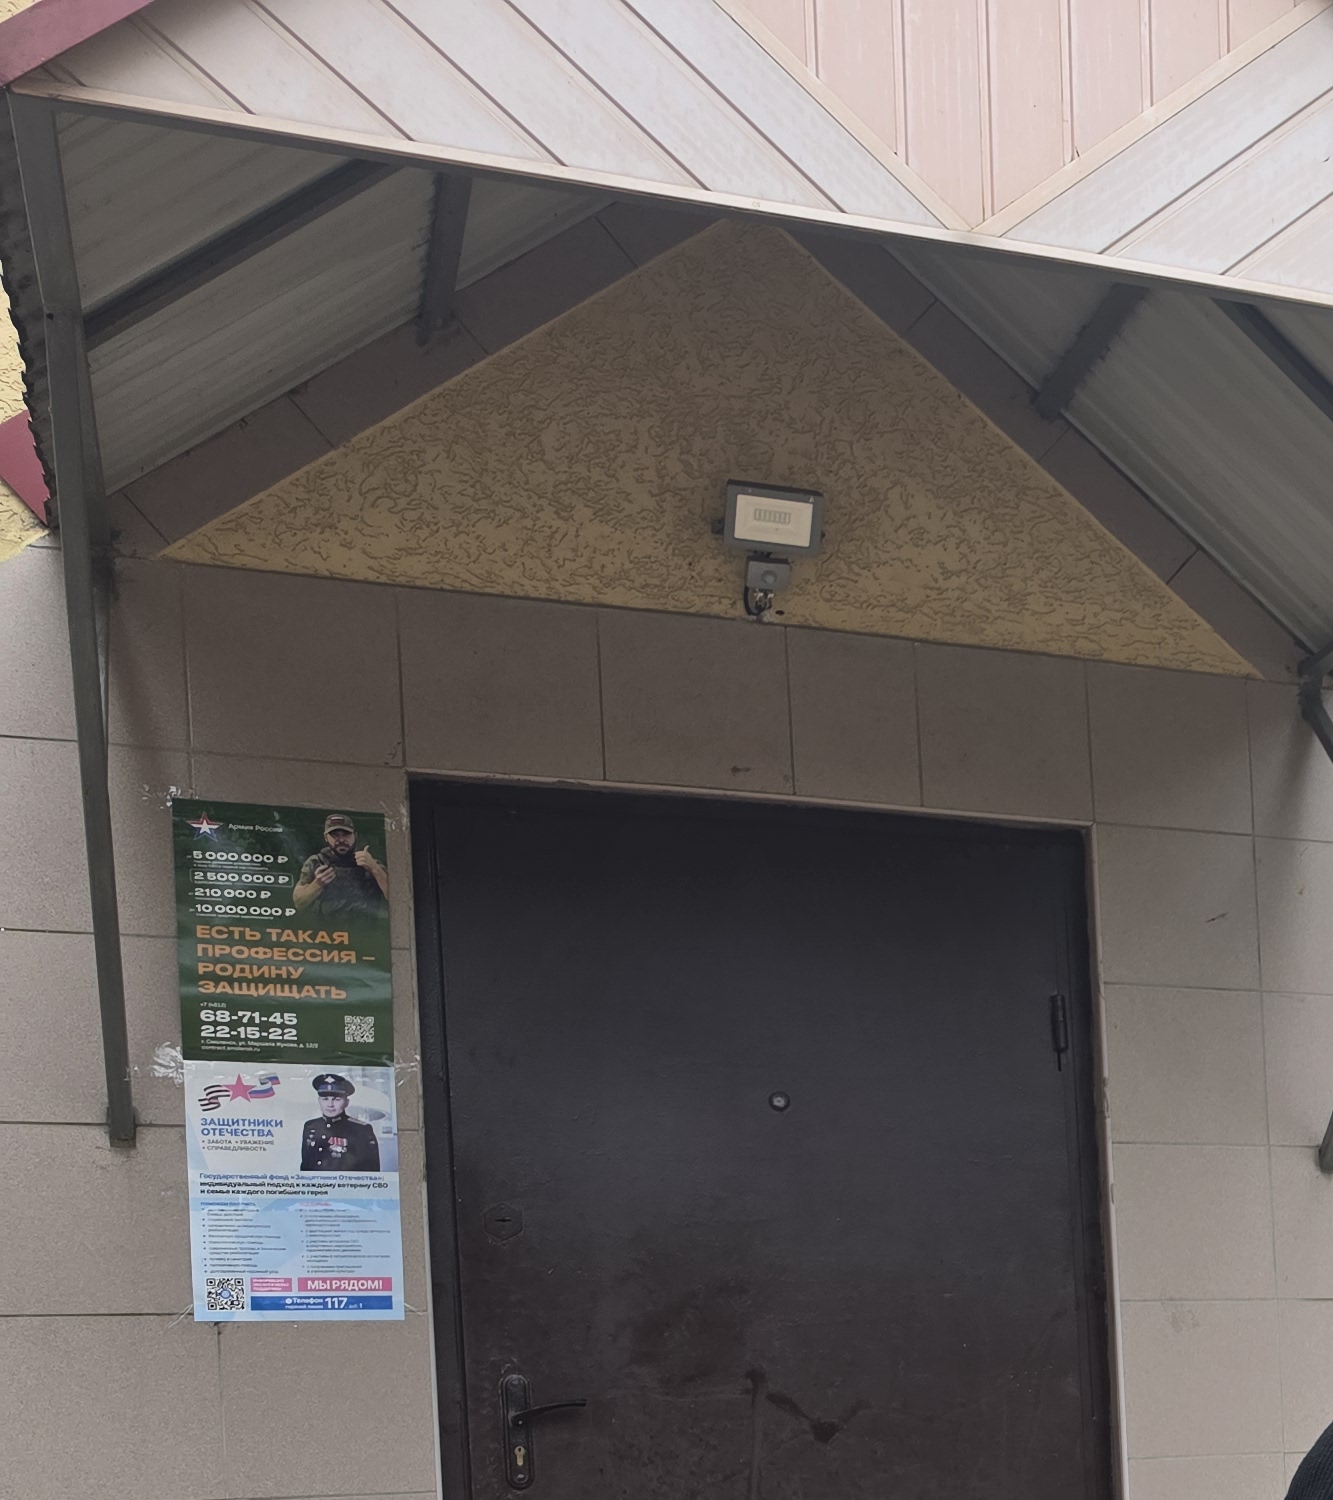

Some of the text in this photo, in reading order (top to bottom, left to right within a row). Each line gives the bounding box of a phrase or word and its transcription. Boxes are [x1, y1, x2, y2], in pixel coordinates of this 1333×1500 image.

[193, 850, 203, 859] 5
[205, 851, 239, 861] 000
[241, 853, 274, 863] 000
[194, 871, 204, 880] 2
[207, 872, 239, 882] 500
[241, 873, 275, 883] 000
[194, 887, 221, 897] 210
[224, 889, 257, 899] 000
[196, 904, 213, 913] 10
[214, 904, 248, 914] 000
[249, 906, 282, 916] 000
[196, 925, 349, 945] ЕСТЬ ТАКАЯ
[197, 943, 357, 964] ПРОФЕССИЯ
[198, 962, 305, 979] РОДИНУ
[198, 980, 347, 999] ЗАЩИЩАТЬ
[200, 1009, 298, 1025] 68-71-45
[200, 1025, 298, 1040] 22-15-22
[201, 1117, 284, 1128] ЗАЩИТНИКИ
[201, 1128, 274, 1137] ОТЕЧЕСТВА
[307, 1279, 383, 1291] МЫ РЯДОМ!
[325, 1297, 348, 1309] 117
